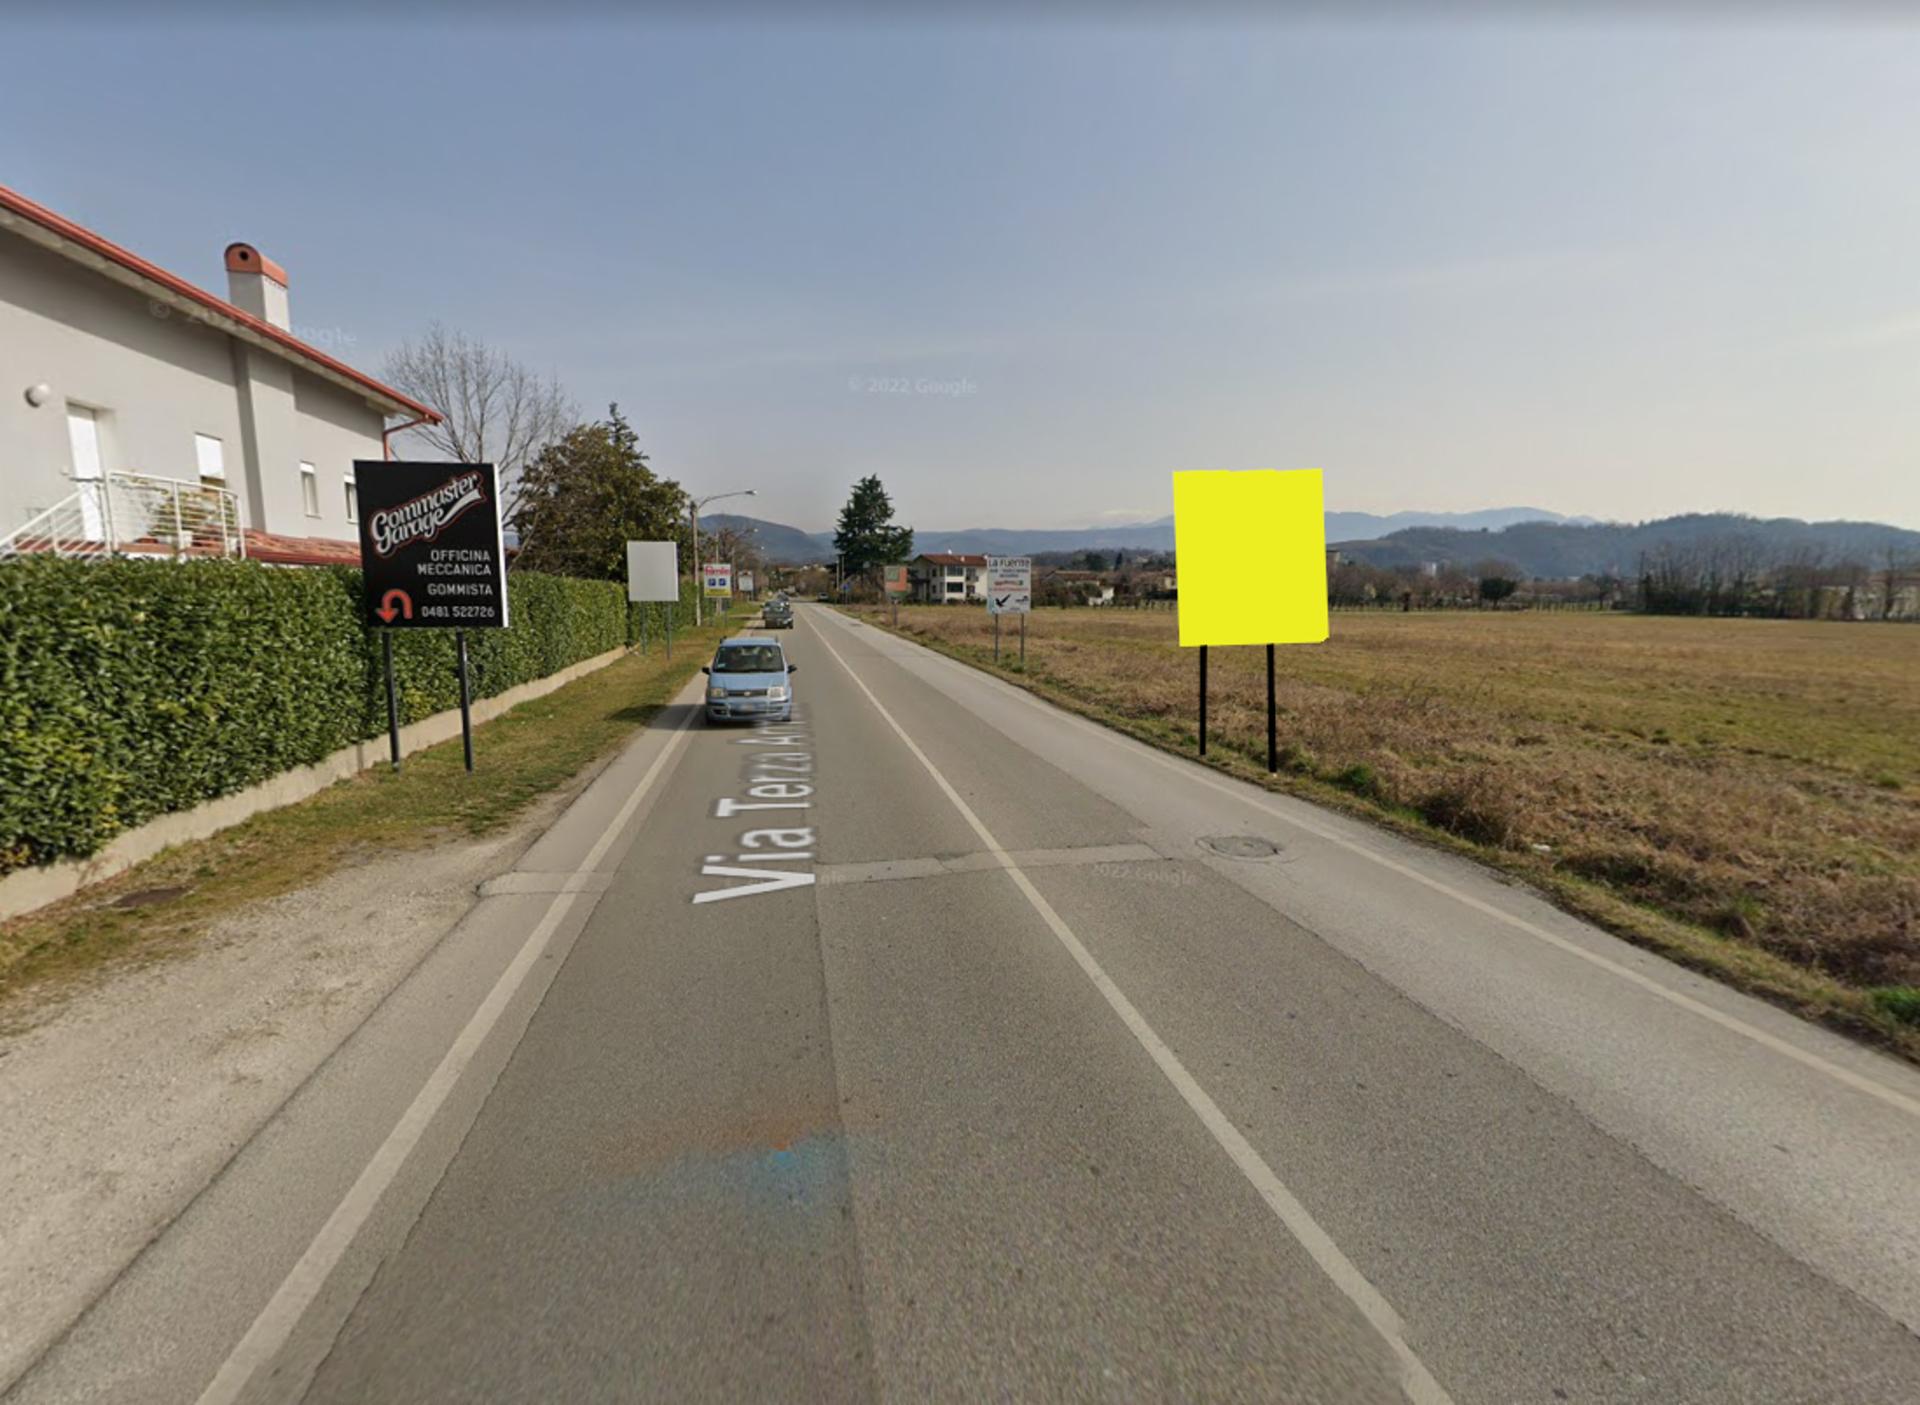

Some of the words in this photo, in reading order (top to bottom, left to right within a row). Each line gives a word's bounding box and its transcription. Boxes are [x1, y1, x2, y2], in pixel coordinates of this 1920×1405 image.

[430, 549, 490, 562] OFFICINA
[417, 563, 492, 576] MECCANICA
[427, 583, 494, 596] GOMMISTA
[421, 606, 451, 618] 0481
[452, 606, 496, 618] 522726
